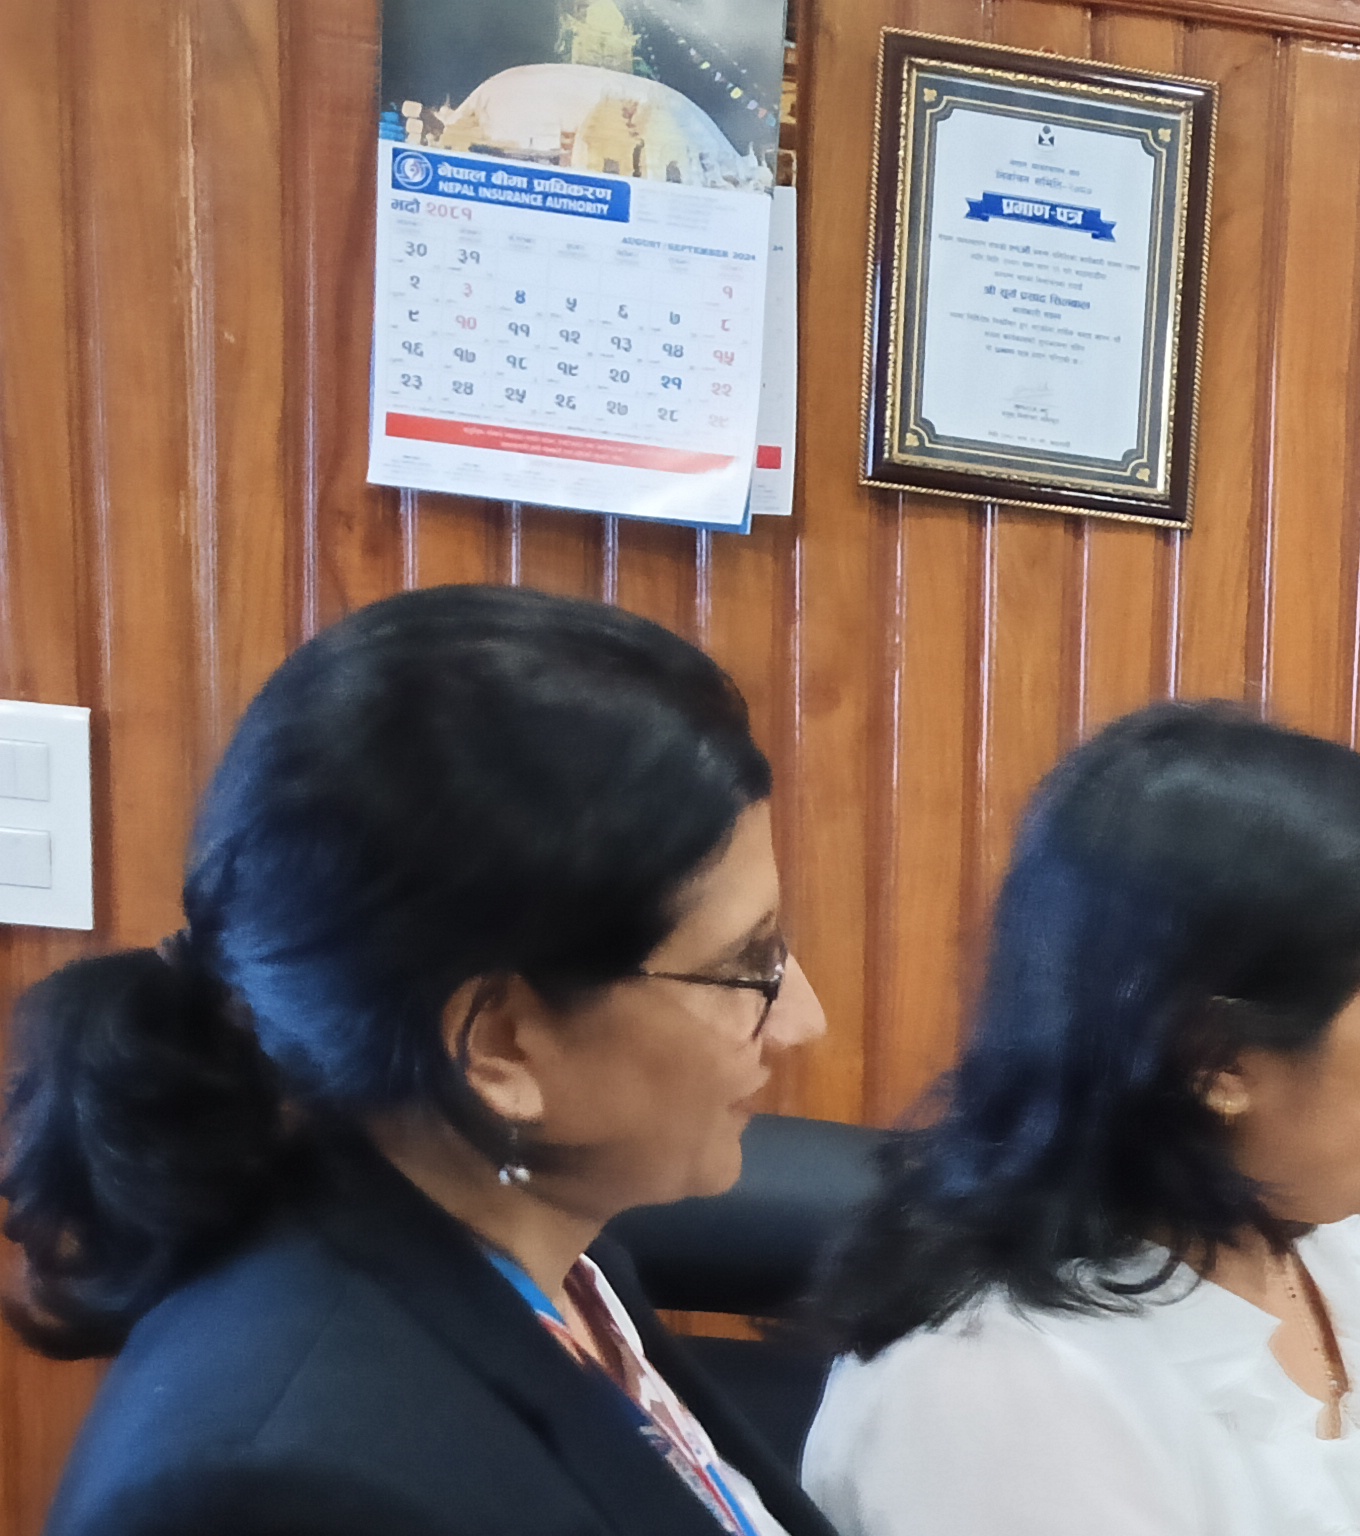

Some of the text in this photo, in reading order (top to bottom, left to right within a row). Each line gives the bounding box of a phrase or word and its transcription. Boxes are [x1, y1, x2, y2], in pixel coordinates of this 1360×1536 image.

[437, 161, 612, 201] नेपाल बीमा प्राधिकरण
[438, 180, 609, 216] NEPAL INSURANCE AUTHORITY
[426, 202, 473, 221] २०८१
[1001, 197, 1084, 225] प्रमाण-पत्र
[404, 240, 428, 258] ३०
[457, 249, 481, 265] ३१
[409, 274, 421, 290] २
[514, 290, 527, 304] ४
[669, 311, 681, 325] ७
[455, 314, 478, 330] १०
[508, 322, 530, 338] ११
[559, 329, 581, 344] १२
[610, 336, 633, 353] १३
[662, 343, 684, 358] १४
[401, 340, 424, 357] १६
[453, 347, 477, 363] १७
[506, 354, 528, 370] १८
[609, 368, 631, 384] २०
[660, 375, 683, 390] २१
[711, 382, 733, 397] २२
[401, 373, 423, 390] २३
[452, 380, 475, 396] २४
[504, 387, 527, 404] २५
[555, 394, 577, 411] २६
[606, 400, 629, 416] २७
